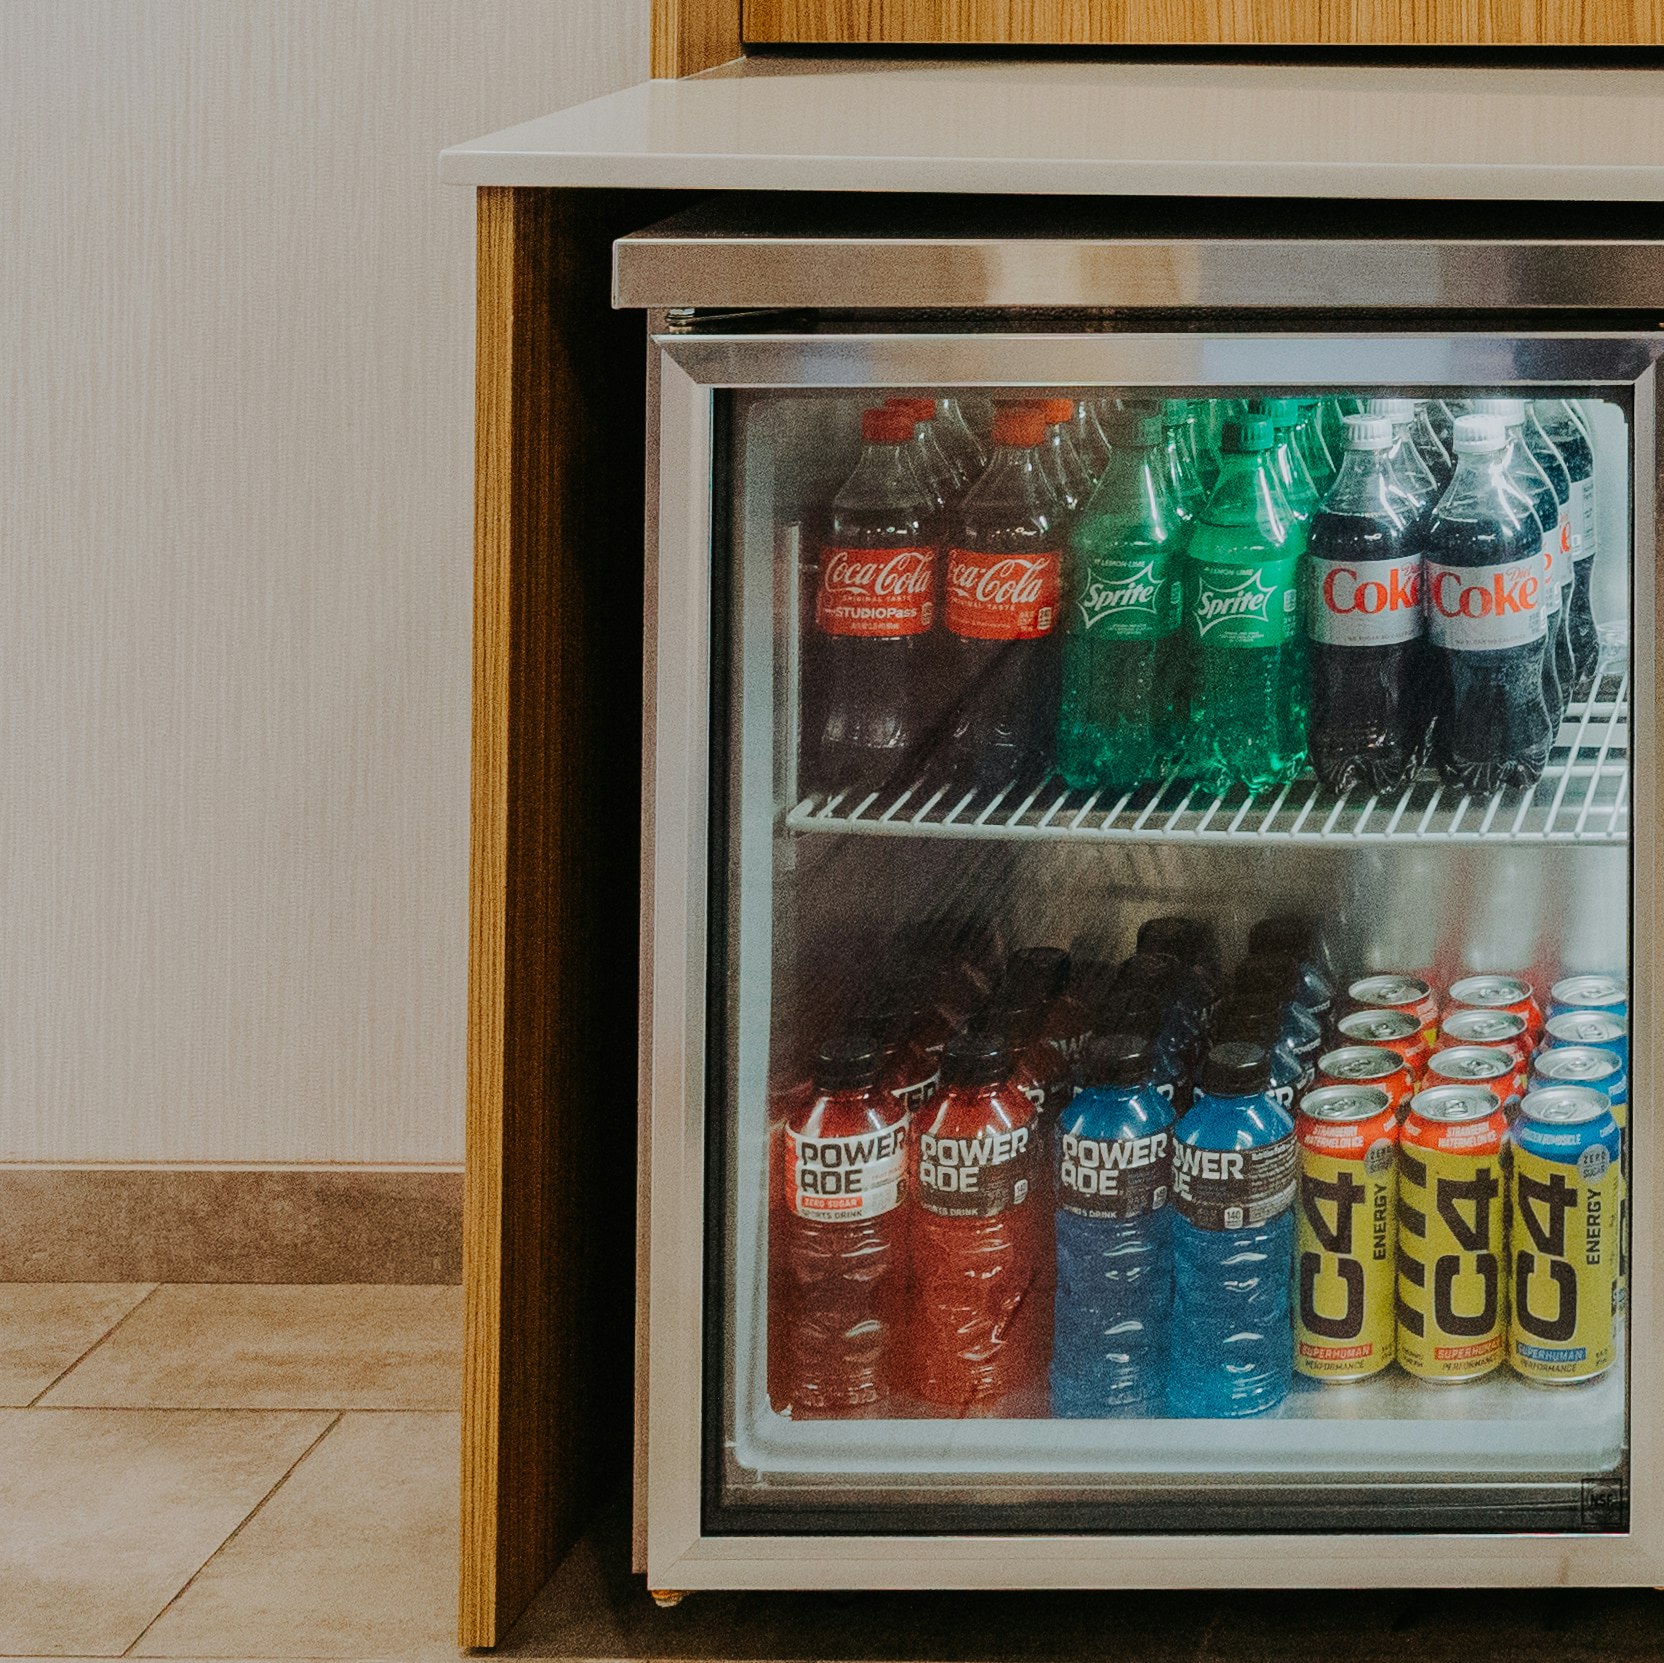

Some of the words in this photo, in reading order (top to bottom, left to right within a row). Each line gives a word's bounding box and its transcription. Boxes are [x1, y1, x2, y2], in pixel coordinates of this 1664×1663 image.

[826, 551, 934, 596] Coca-Cola
[1084, 582, 1154, 612] Sprite
[1198, 590, 1264, 620] Sprite
[1432, 570, 1538, 619] Coke
[801, 1125, 907, 1169] POWER
[921, 1126, 1029, 1166] POWER
[1062, 1132, 1168, 1169] POWER
[800, 1168, 863, 1195] ADE
[920, 1162, 980, 1193] ADE
[1061, 1160, 1120, 1196] ADE
[804, 1197, 826, 1208] ZERO
[828, 1197, 858, 1208] SUGAR
[835, 1209, 863, 1219] DRINK
[950, 1206, 979, 1217] DRINK
[1226, 1210, 1242, 1221] 140
[1373, 1183, 1389, 1261] ENERGY
[1586, 1187, 1602, 1266] ENERGY
[1302, 1172, 1365, 1339] C4
[1435, 1168, 1499, 1337] C4
[1517, 1172, 1579, 1342] C4
[1302, 1343, 1372, 1360] SUPERHUMAN
[1517, 1343, 1586, 1362] SUPERHUMAN
